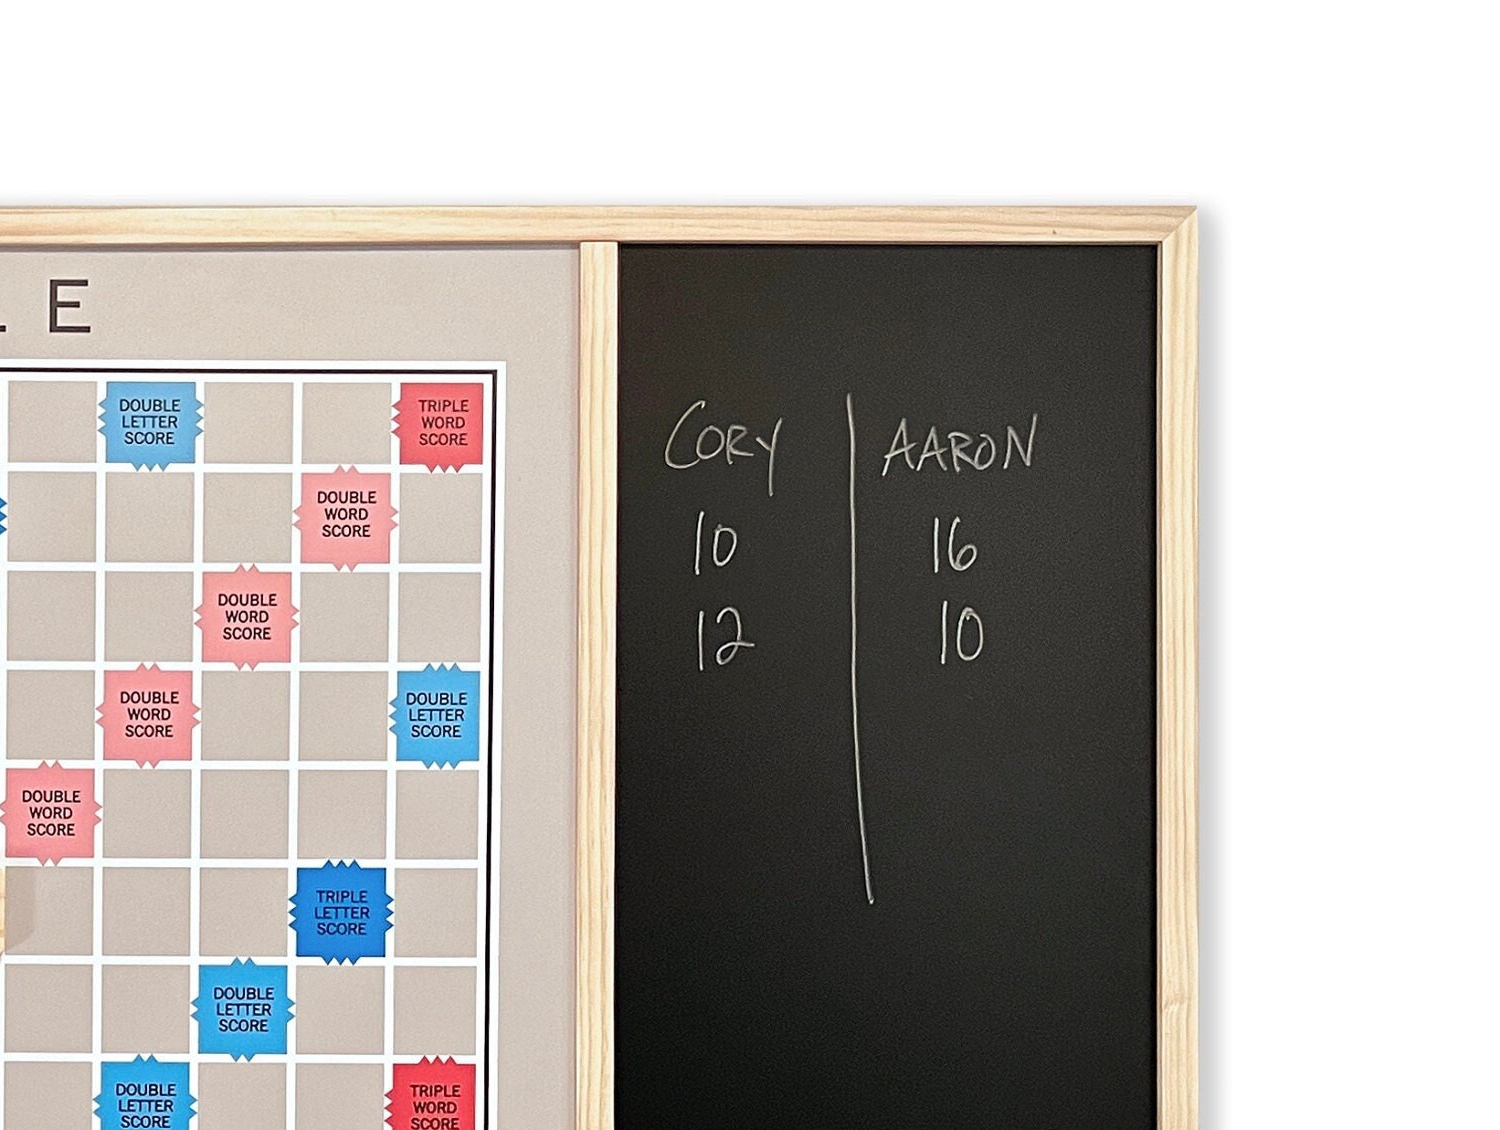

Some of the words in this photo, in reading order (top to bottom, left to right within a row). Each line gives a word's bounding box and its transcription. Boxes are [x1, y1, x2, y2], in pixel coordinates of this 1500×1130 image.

[119, 398, 181, 413] DOUBLE
[418, 399, 469, 413] TRIPLE
[122, 415, 178, 429] LETTER
[421, 416, 466, 429] WORD
[124, 431, 174, 445] SCORE
[419, 432, 467, 446] SCORE
[882, 413, 1038, 476] AARON
[665, 401, 783, 497] CORY
[695, 512, 738, 576] 10
[934, 517, 978, 574] 16
[699, 607, 755, 671] 12
[941, 601, 984, 665] 10
[120, 691, 180, 705] DOUBLE
[406, 692, 468, 706] DOUBLE
[127, 707, 171, 721] WORD
[409, 708, 465, 722] LETTER
[125, 724, 174, 738] SCORE
[411, 724, 461, 738] SCORE
[213, 986, 275, 1001] DOUBLE
[216, 1002, 272, 1017] LETTER
[219, 1018, 268, 1033] SCORE
[115, 1083, 177, 1097] DOUBLE
[410, 1084, 461, 1098] TRIPLE
[118, 1098, 174, 1113] LETTER
[413, 1101, 457, 1114] WORD
[120, 1115, 171, 1129] SCORE
[410, 1117, 459, 1130] SCORE
